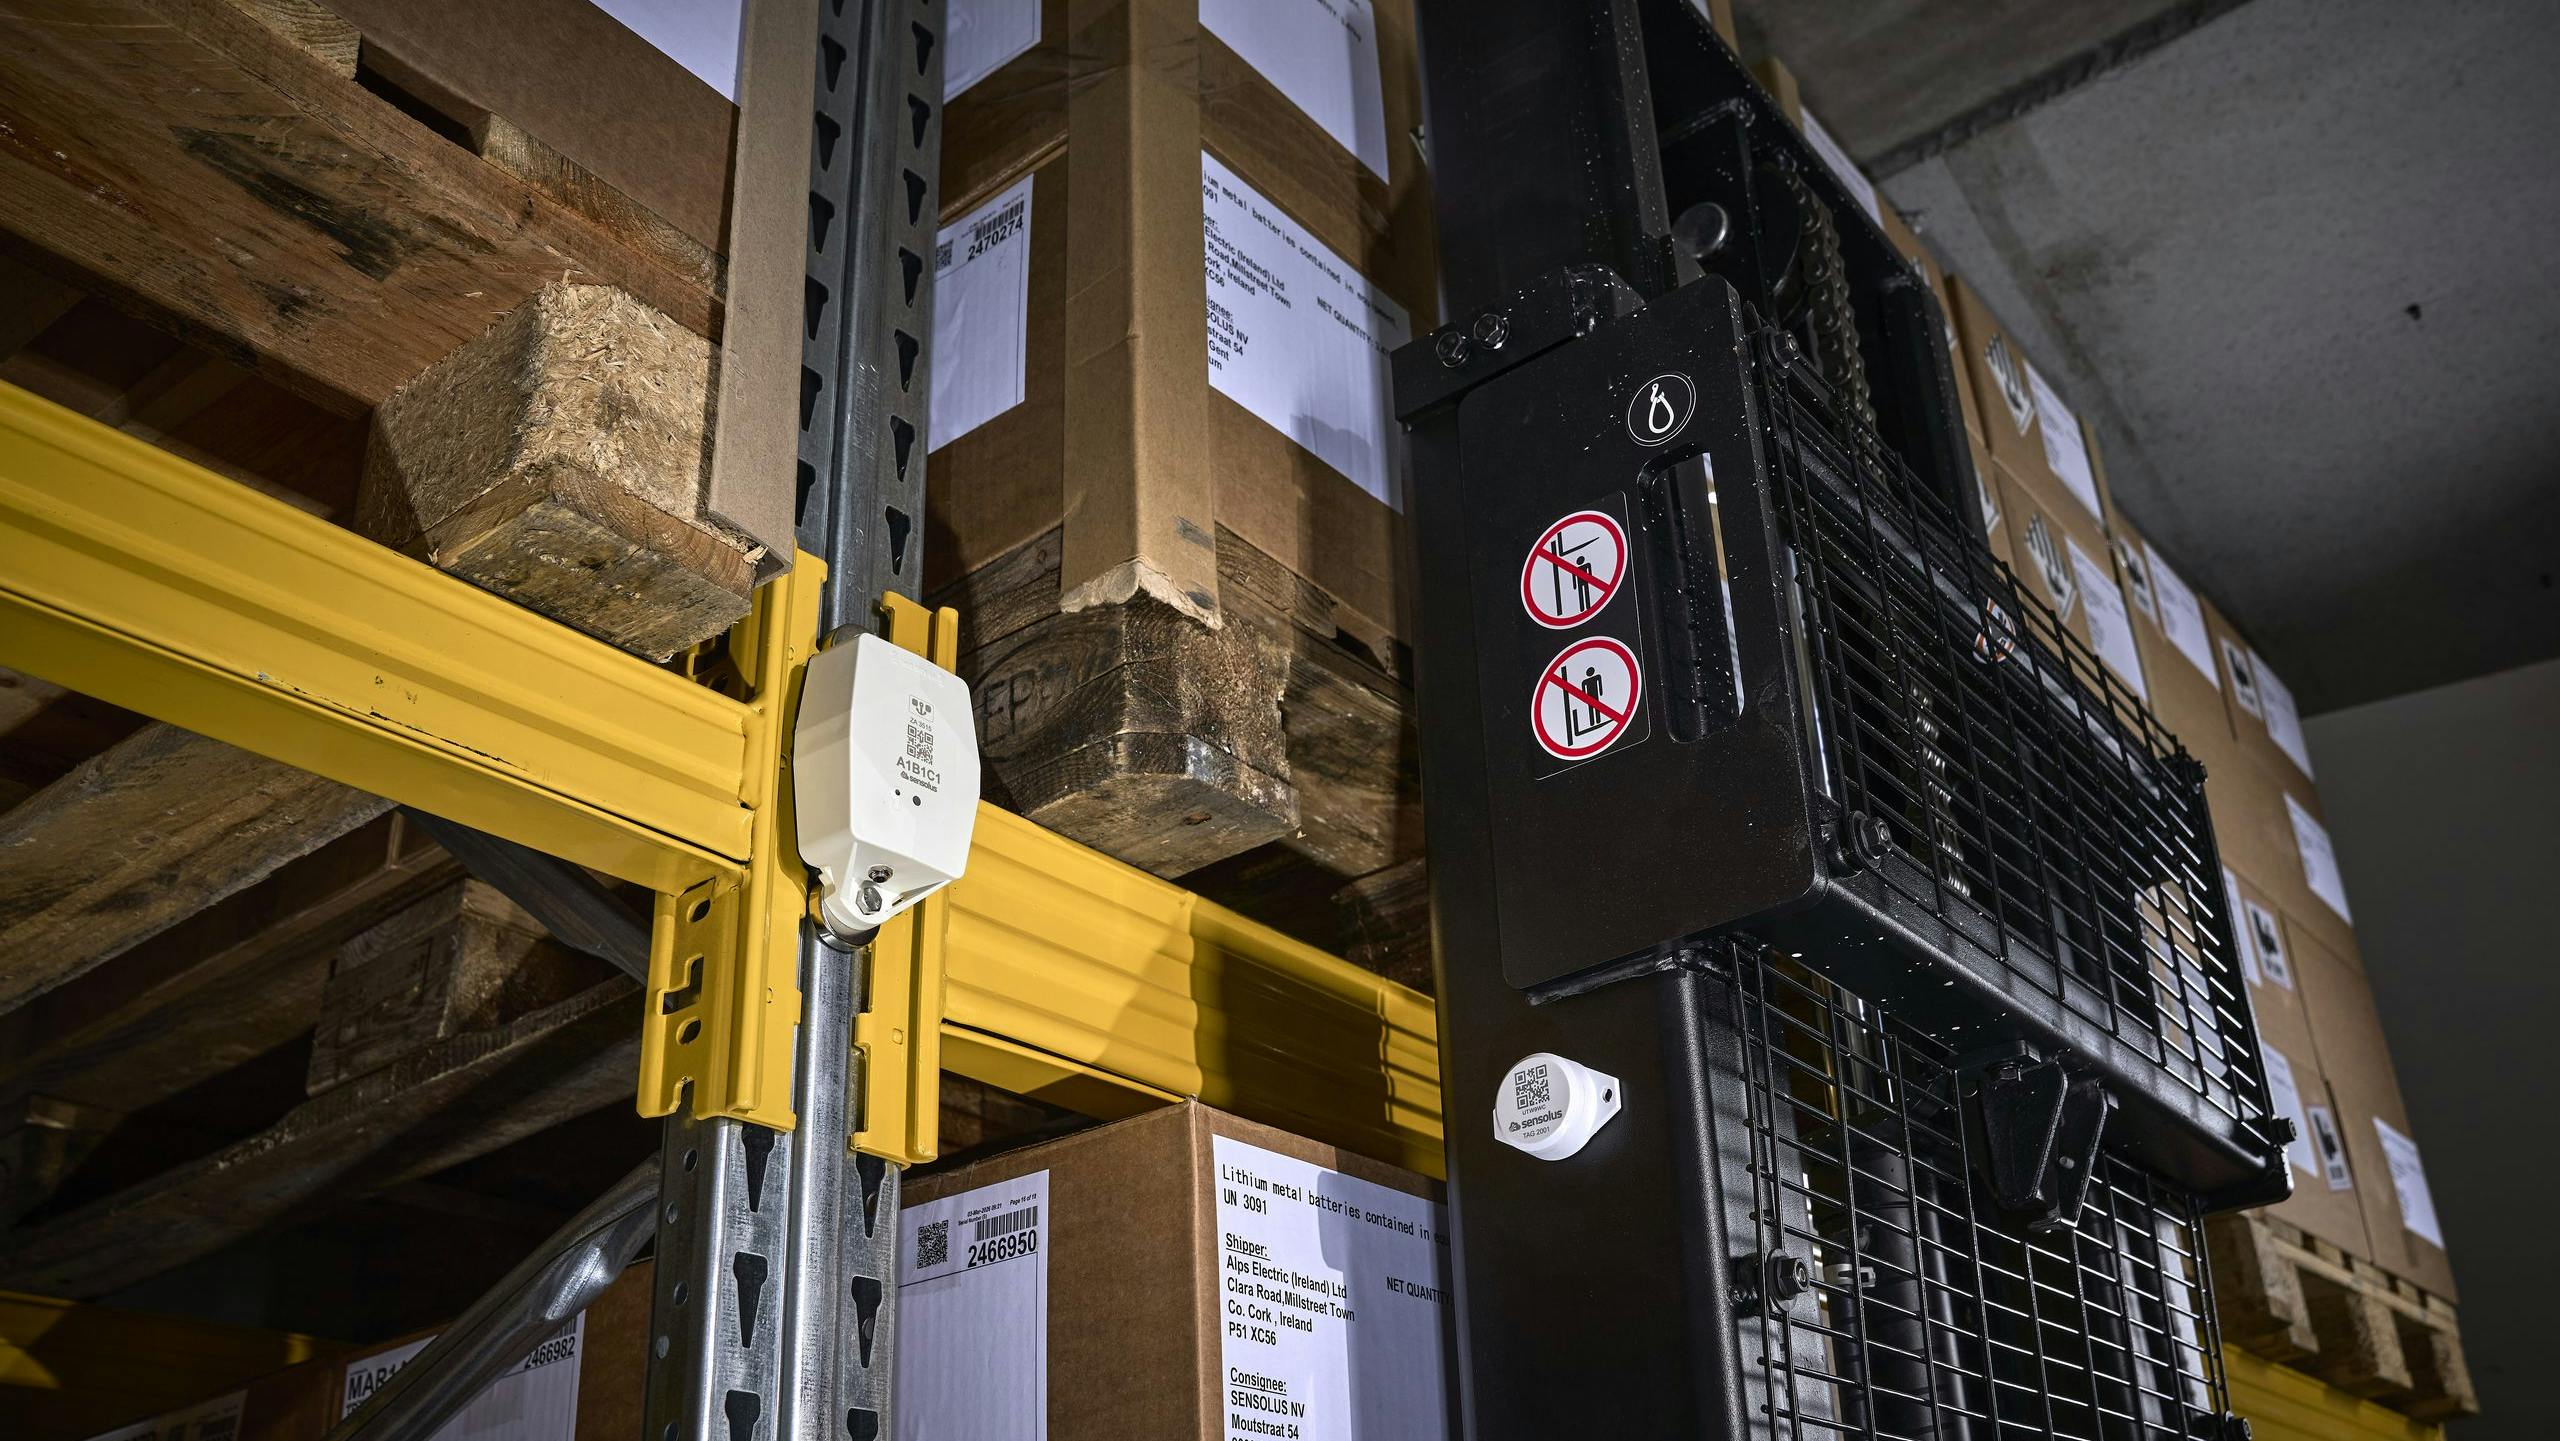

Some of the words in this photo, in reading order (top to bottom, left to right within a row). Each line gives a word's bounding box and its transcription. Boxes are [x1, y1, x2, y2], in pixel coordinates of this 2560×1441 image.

[1203, 184, 1219, 204] 091
[967, 215, 1024, 262] 2470274
[1204, 170, 1219, 190] ium
[1222, 186, 1248, 211] metal
[1252, 207, 1296, 249] batteries
[1299, 247, 1341, 283] contained
[1205, 226, 1236, 255] Electric
[1237, 249, 1271, 282] (Ireland)
[1271, 274, 1285, 291] Ltd
[1227, 271, 1256, 296] Ireland
[1269, 285, 1292, 309] Town
[1207, 295, 1233, 321] ignee:
[1317, 296, 1333, 314] NET
[1206, 308, 1235, 336] SOLUS
[1236, 329, 1249, 345] NV
[1207, 325, 1232, 348] straat
[1233, 342, 1244, 357] 54
[1208, 340, 1230, 361] Gent
[1208, 356, 1223, 371] um
[896, 756, 941, 785] A1B1C1
[909, 775, 938, 793] sensolus
[1521, 1110, 1563, 1129] sensolus
[1523, 1130, 1536, 1139] TAG
[1536, 1126, 1550, 1136] 2001
[1009, 1197, 1021, 1206] Page
[1222, 1163, 1268, 1192] Lithium
[1272, 1183, 1302, 1202] metal
[1308, 1190, 1361, 1219] batteries
[1365, 1211, 1414, 1236] contained
[1419, 1223, 1430, 1241] in
[1223, 1187, 1237, 1206] UN
[1243, 1193, 1267, 1215] 3091
[967, 1229, 1037, 1268] 2466950
[1226, 1232, 1269, 1258] Shipper:
[1226, 1255, 1250, 1275] Alps
[1252, 1261, 1289, 1284] Electric
[1291, 1270, 1330, 1298] (Ireland)
[1332, 1281, 1347, 1299] Ltd
[1386, 1275, 1404, 1293] NET
[1227, 1276, 1254, 1295] Clara
[1257, 1284, 1328, 1316] Road,Millstreet
[1330, 1302, 1355, 1322] Town
[1228, 1299, 1246, 1317] Co.
[1248, 1304, 1272, 1323] Cork
[1279, 1311, 1313, 1333] Ireland
[1228, 1321, 1247, 1340] P51
[1250, 1327, 1277, 1346] XC56
[524, 1336, 576, 1369] 2466982
[347, 1361, 407, 1401] MAR
[1230, 1366, 1287, 1393] Consignee:
[1231, 1390, 1288, 1415] SENSOLUS
[1290, 1401, 1305, 1419] NV
[1231, 1413, 1285, 1438] Moutstraat
[1287, 1424, 1299, 1440] 54
